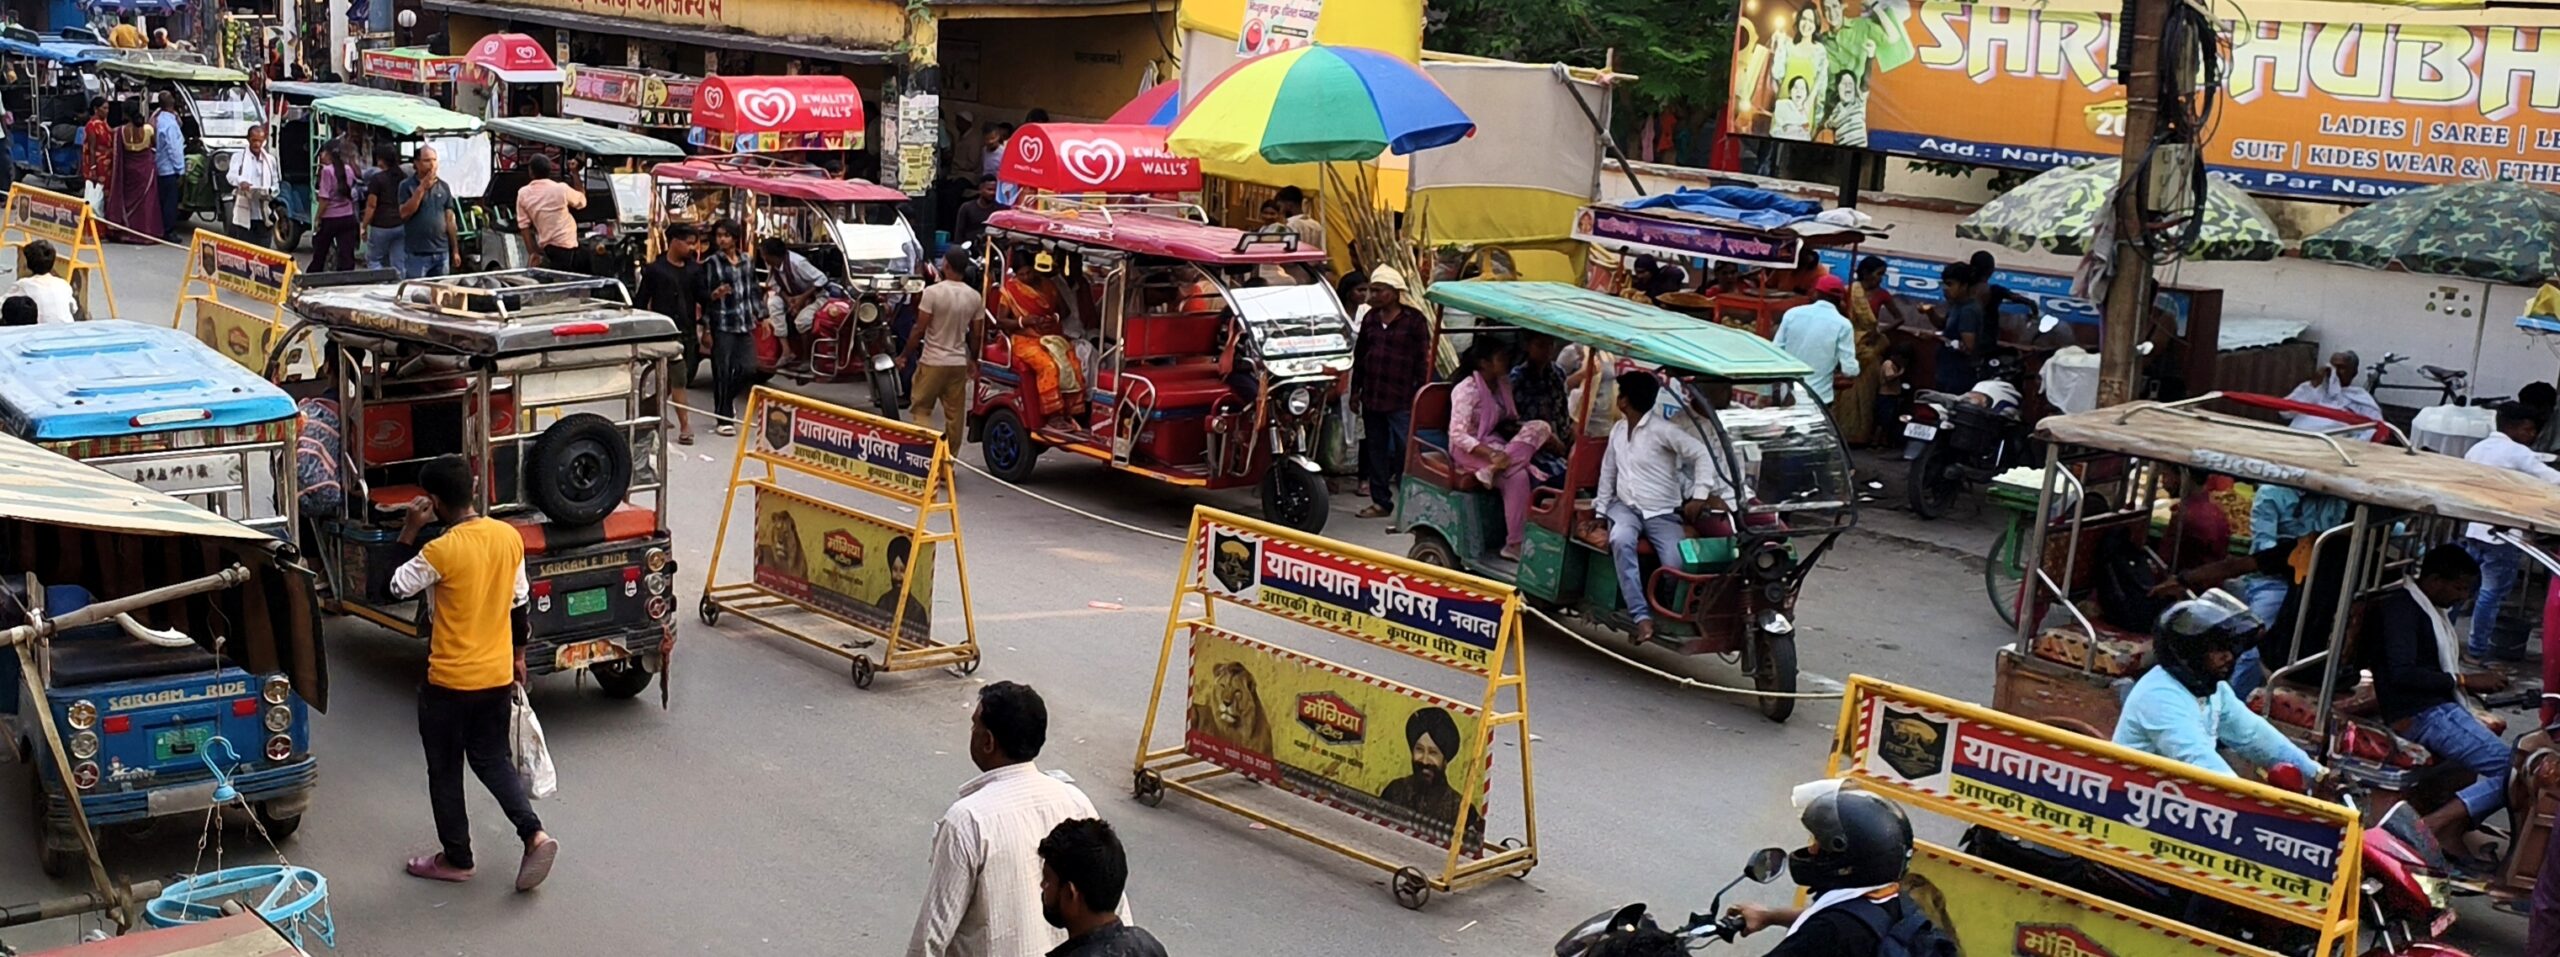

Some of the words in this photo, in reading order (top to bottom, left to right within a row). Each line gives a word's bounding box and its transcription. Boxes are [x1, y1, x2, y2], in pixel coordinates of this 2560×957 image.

[802, 93, 855, 106] KWALITY
[811, 106, 852, 118] WALL'S
[2320, 114, 2405, 138] LADIES
[2430, 123, 2509, 146] SAREE
[1141, 162, 1188, 176] WALL'S
[2233, 140, 2286, 161] SUIT
[2308, 147, 2378, 169] KIDES
[2385, 153, 2455, 177] WEAR
[2265, 173, 2322, 190] Par
[2331, 179, 2408, 197] Naw
[797, 416, 853, 450] यातायात
[857, 429, 902, 464] पुलिस,
[905, 451, 932, 471] नवाद
[539, 557, 587, 576] SARGAM
[602, 551, 629, 566] RIDE
[1265, 550, 1361, 600] यातायात
[1367, 576, 1443, 627] पुलिस,
[1448, 609, 1498, 640] नवादा
[1261, 590, 1308, 614] आपकी
[1312, 603, 1337, 623] सेवा
[1341, 609, 1353, 627] में
[1386, 624, 1428, 648] कृपया
[1432, 635, 1458, 656] धीरे
[109, 688, 184, 711] SARGAM
[206, 680, 246, 700] RIDE
[1961, 734, 2113, 805] यातायात
[2122, 777, 2244, 846] पुलिस,
[2253, 825, 2335, 869] नवादा
[1952, 778, 2025, 814] आपकी
[2031, 798, 2072, 826] सेवा
[2077, 808, 2098, 835] में
[2149, 834, 2216, 869] कृपया
[2223, 851, 2266, 883] धीरे
